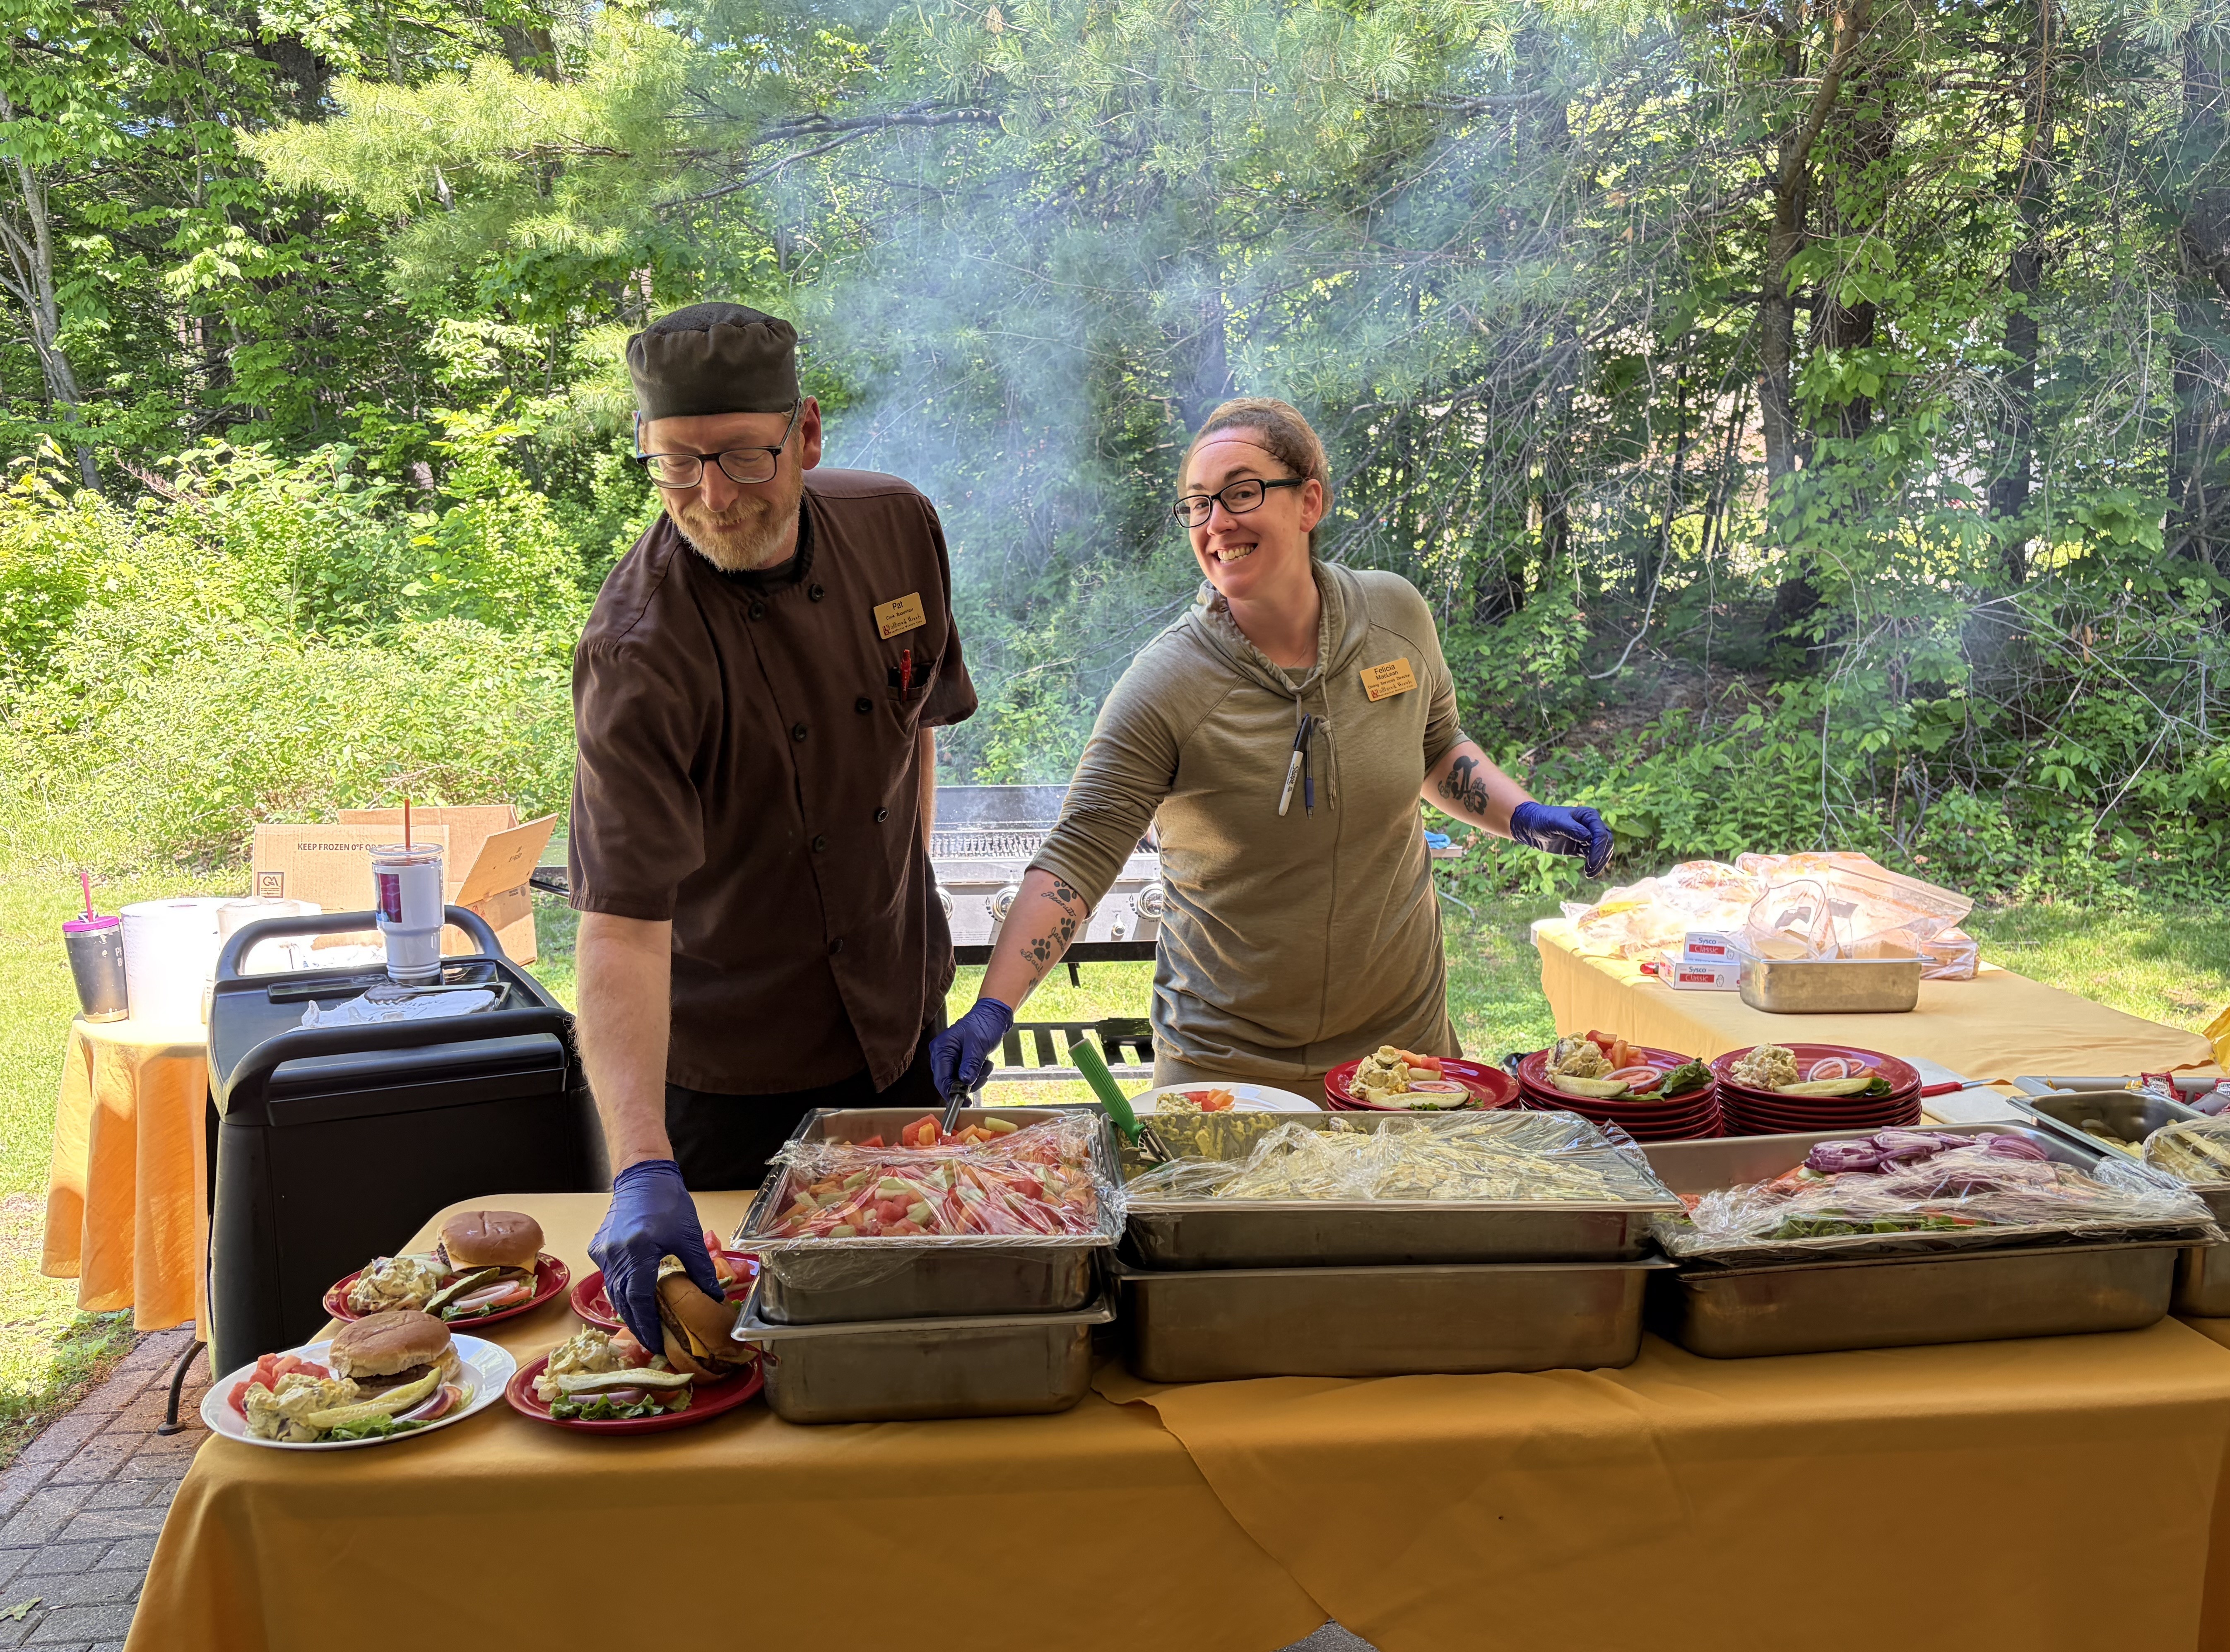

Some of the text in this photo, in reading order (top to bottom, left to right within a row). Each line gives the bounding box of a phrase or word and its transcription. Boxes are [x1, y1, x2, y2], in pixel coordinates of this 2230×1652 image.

[892, 601, 903, 610] Pat
[1374, 664, 1396, 674] Felicia
[1376, 671, 1399, 680] MacLean
[1041, 891, 1076, 917] Peanut
[1695, 945, 1718, 954] Classic
[1020, 949, 1043, 976] Basil
